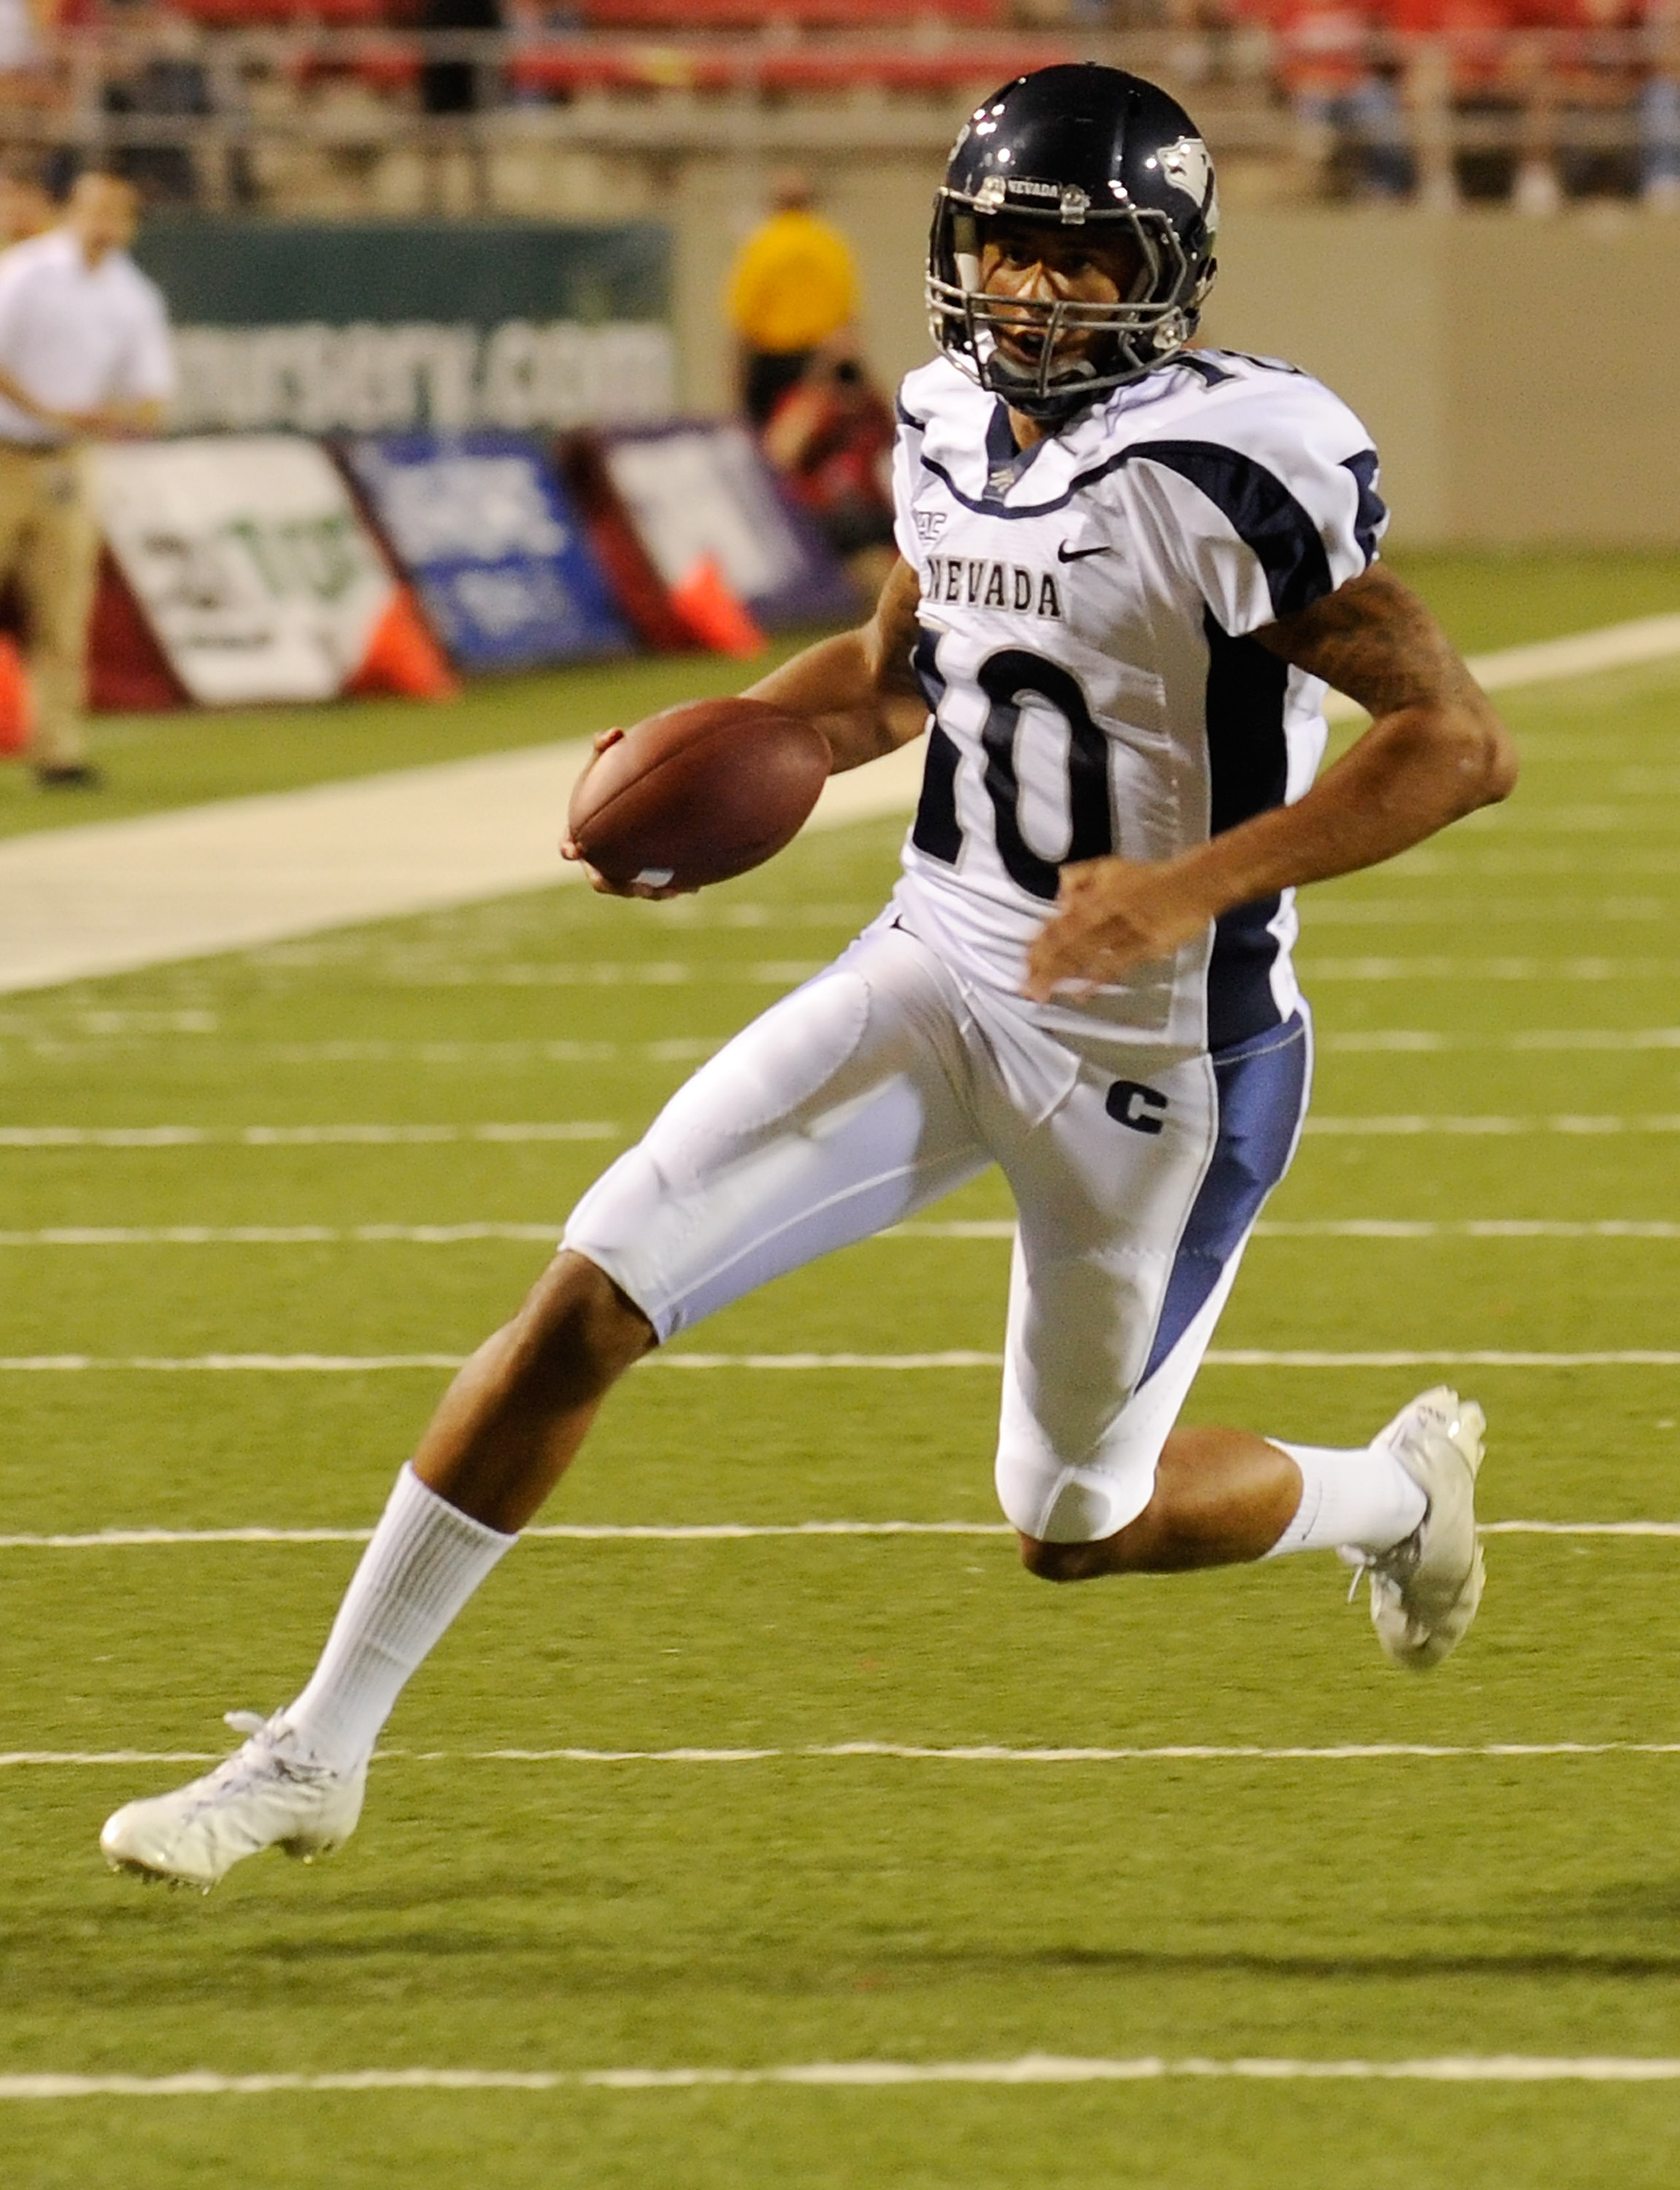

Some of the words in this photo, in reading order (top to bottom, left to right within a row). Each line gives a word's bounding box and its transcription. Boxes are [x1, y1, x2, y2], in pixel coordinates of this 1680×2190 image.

[1008, 180, 1058, 198] NEVADA
[925, 555, 1066, 620] NEVADA
[909, 628, 1115, 904] 10
[1105, 1079, 1169, 1135] C
